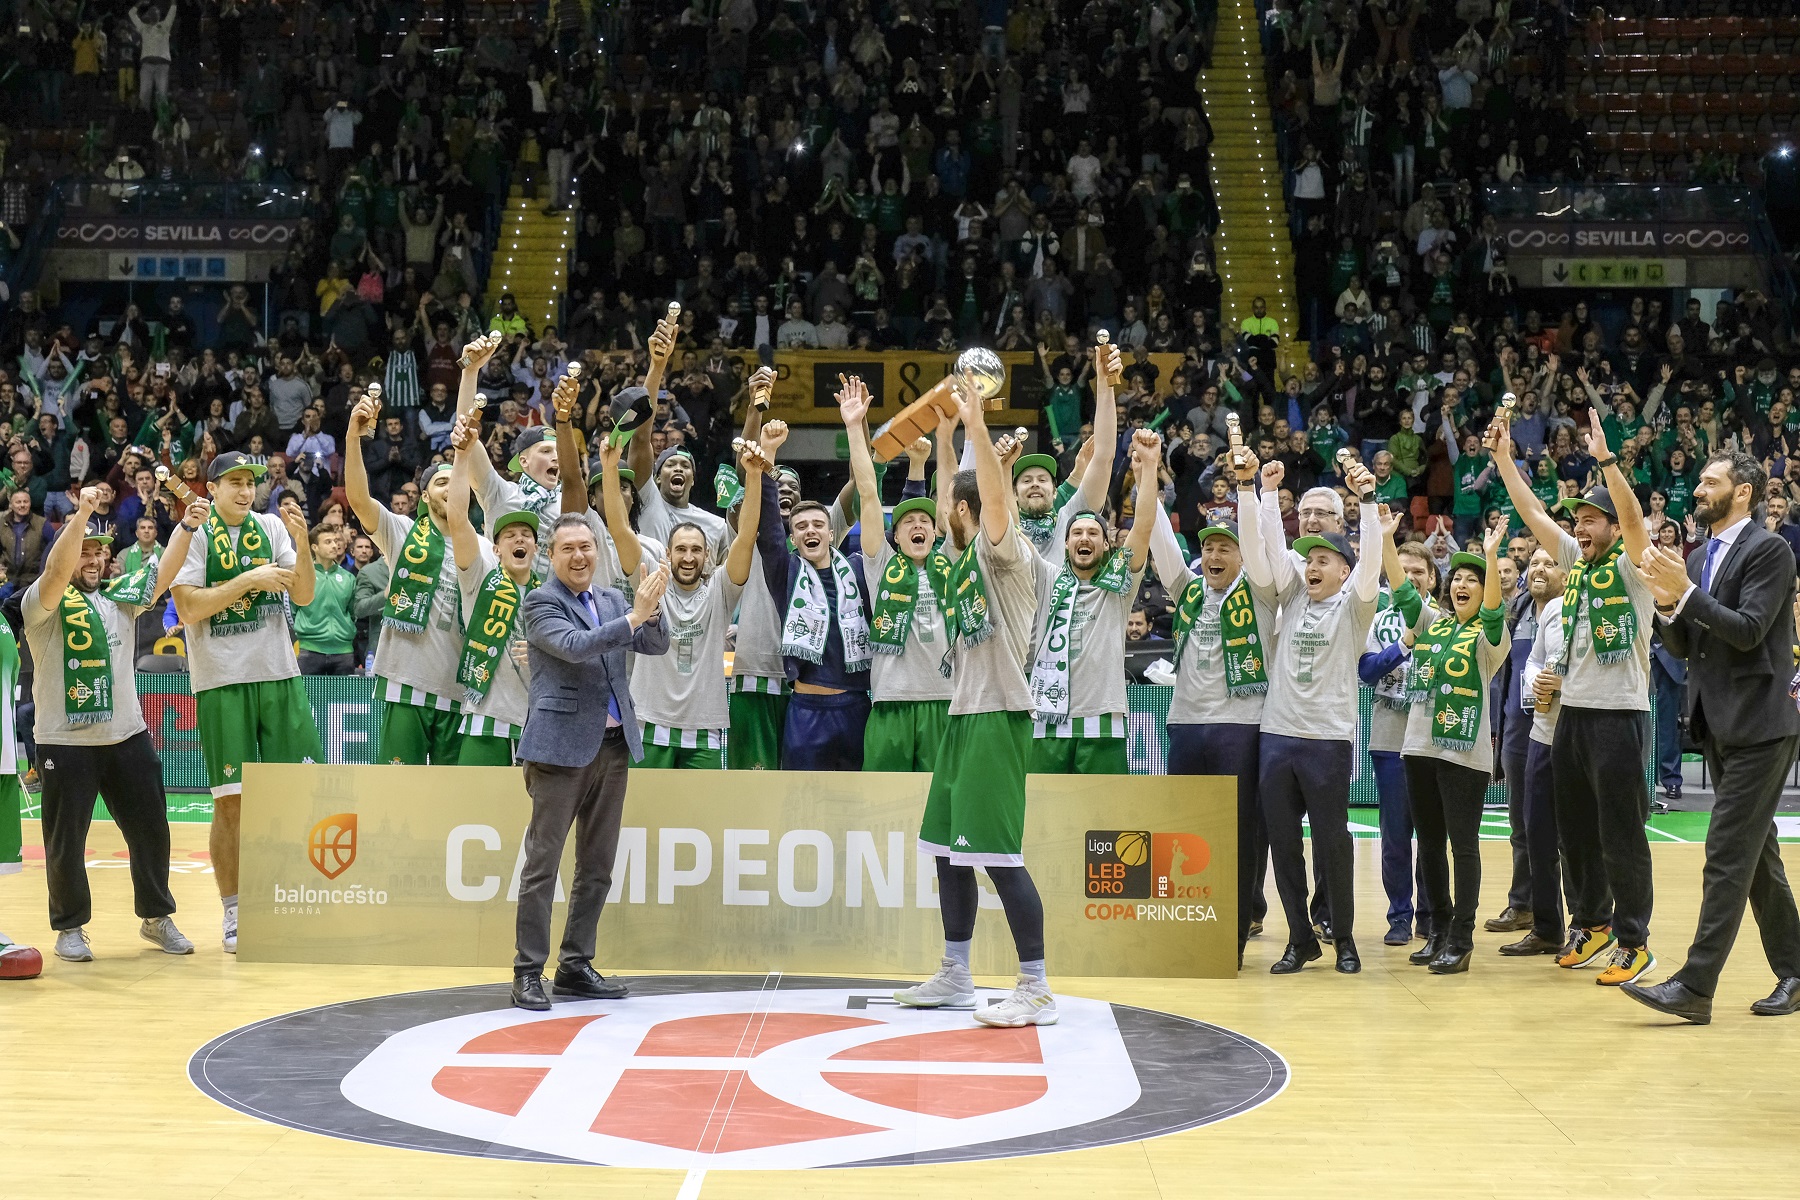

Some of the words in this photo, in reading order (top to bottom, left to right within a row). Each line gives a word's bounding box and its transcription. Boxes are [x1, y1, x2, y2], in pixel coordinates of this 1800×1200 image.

[144, 225, 222, 241] SEVILLA
[1575, 230, 1656, 246] SEVILLA
[1088, 839, 1112, 854] Liga
[1088, 863, 1126, 879] LEB
[1088, 881, 1124, 894] ORO
[1158, 875, 1168, 898] FEB
[1177, 885, 1212, 899] 2019
[274, 905, 321, 915] ESPAÑA
